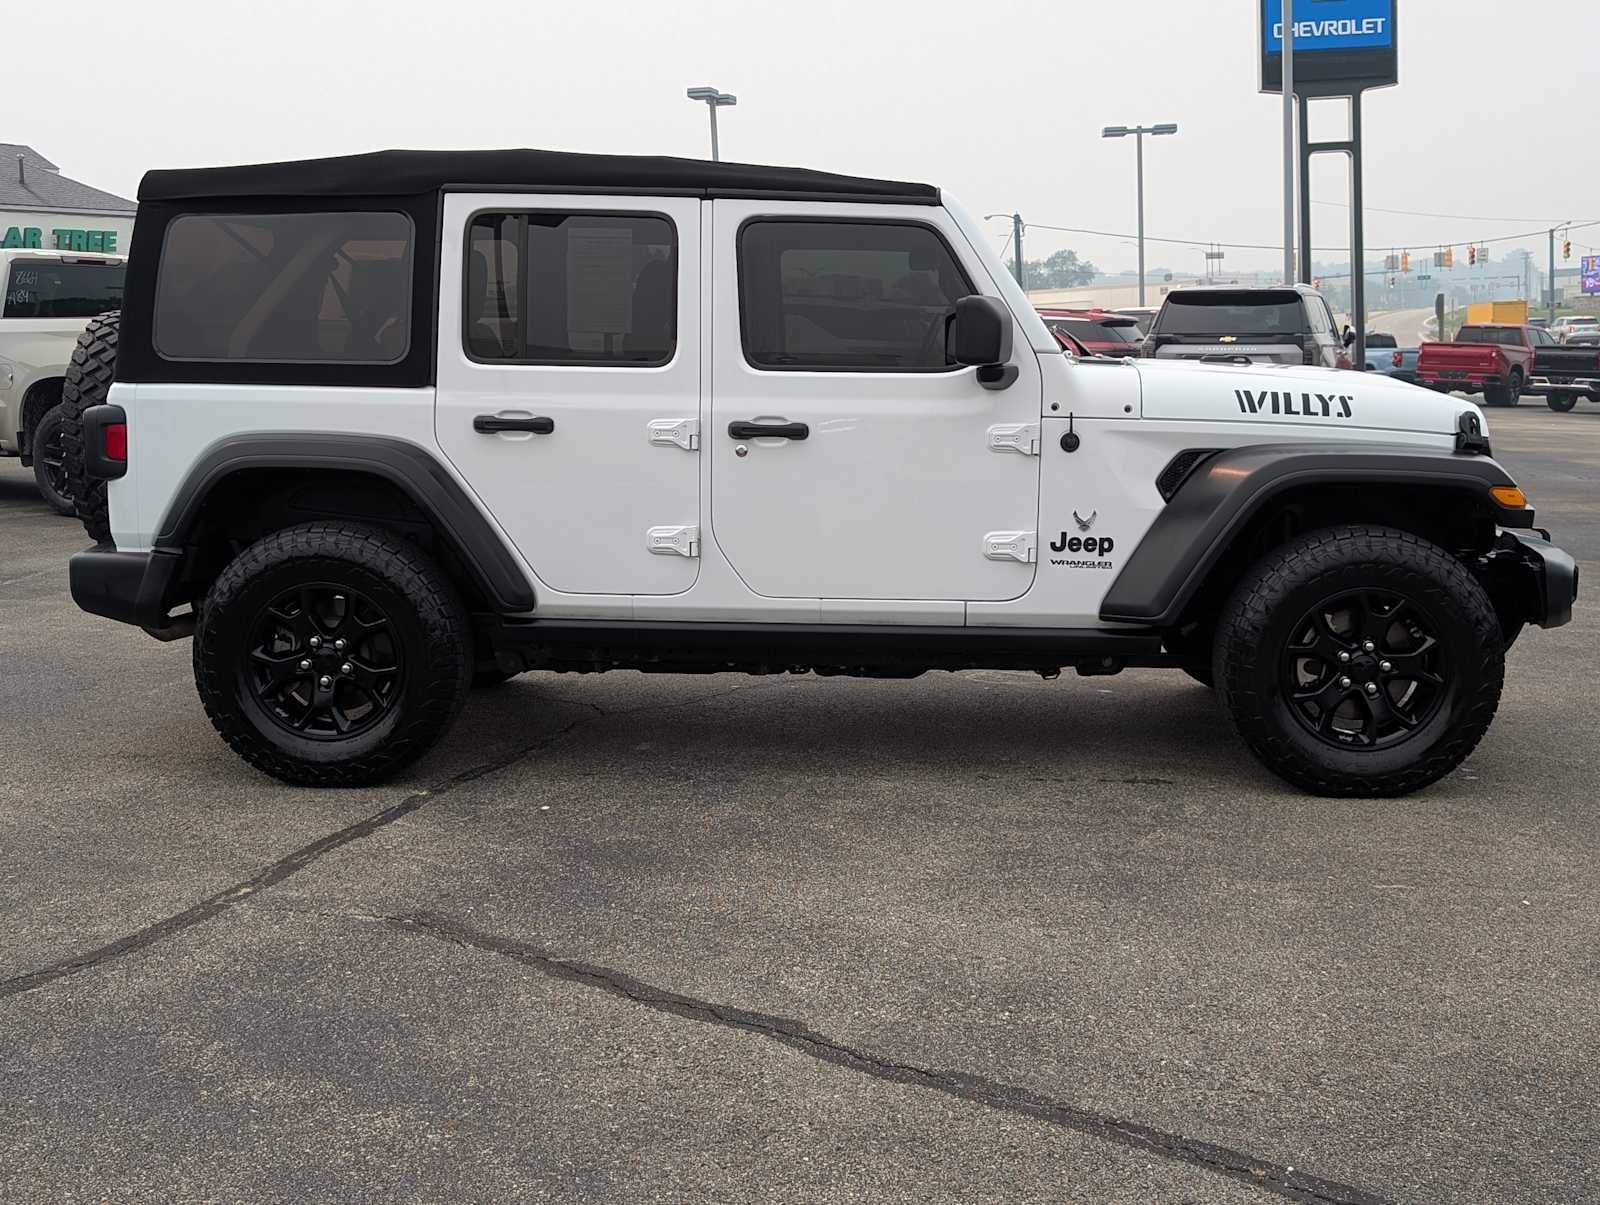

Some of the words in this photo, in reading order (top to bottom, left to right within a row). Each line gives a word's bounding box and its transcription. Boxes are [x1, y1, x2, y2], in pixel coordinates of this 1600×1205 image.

[1273, 18, 1386, 39] CHEVROLET
[0, 227, 42, 248] AR
[53, 229, 117, 252] TREE
[1234, 389, 1354, 418] WILLYS
[1050, 531, 1114, 557] Jeep
[1050, 559, 1112, 567] WRANGLER
